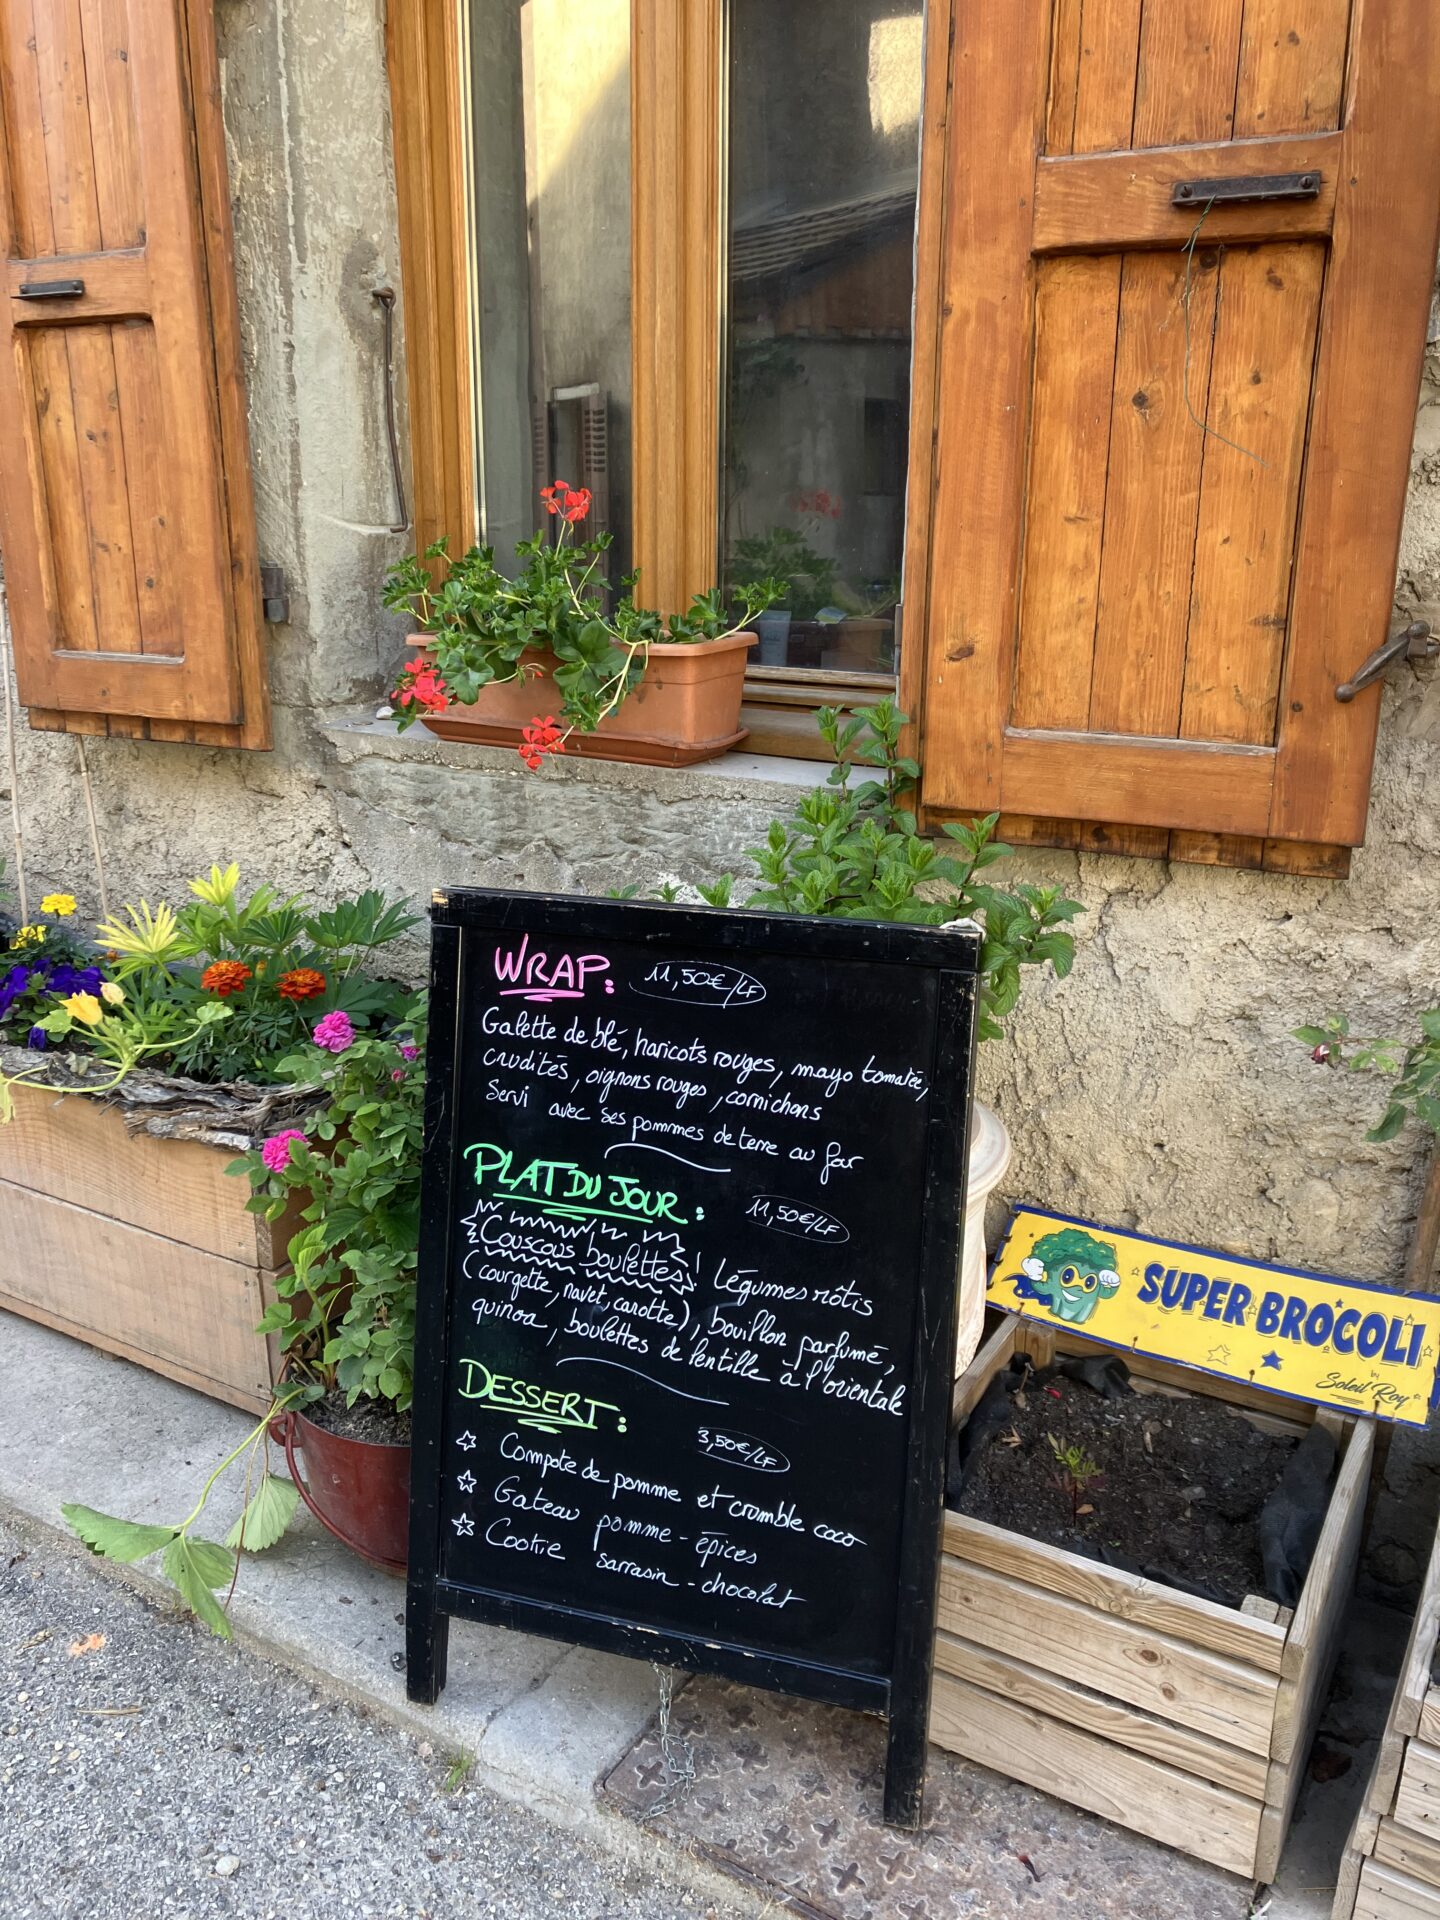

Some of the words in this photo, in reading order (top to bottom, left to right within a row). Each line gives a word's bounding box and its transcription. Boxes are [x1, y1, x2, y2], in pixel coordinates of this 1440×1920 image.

[495, 933, 616, 993] WRAP:
[482, 1006, 557, 1040] Galette
[563, 1016, 588, 1045] de
[591, 1017, 630, 1060] blé,
[634, 1028, 708, 1064] haricots
[713, 1054, 784, 1090] rouges,
[790, 1064, 853, 1098] mayo
[585, 1067, 651, 1104] oignons
[725, 1092, 823, 1121] cornichons
[463, 1143, 579, 1196] PLAT
[563, 1170, 602, 1200] DU
[548, 1102, 591, 1121] avec
[600, 1107, 627, 1126] ses
[631, 1115, 705, 1142] pommes
[713, 1123, 736, 1147] de
[738, 1126, 779, 1156] terre
[789, 1147, 816, 1162] au
[820, 1141, 865, 1186] four
[480, 1214, 576, 1259] Couscous
[707, 1305, 788, 1347] bouillon
[811, 1279, 873, 1317] rôtis
[1136, 1262, 1253, 1328] SUPER
[1255, 1290, 1427, 1369] BROCOLI
[563, 1307, 649, 1354] boulettes
[661, 1336, 683, 1361] de
[688, 1338, 771, 1382] lentille
[1315, 1371, 1374, 1394] Soleil
[1370, 1382, 1411, 1411] Roy
[1370, 1369, 1380, 1381] by
[494, 1475, 580, 1521] Gateau
[593, 1514, 672, 1552] pomme
[500, 1432, 577, 1479] Compote
[581, 1458, 610, 1484] de
[612, 1472, 682, 1500] pomme
[697, 1484, 735, 1509] et
[813, 1523, 868, 1547] coco
[701, 1572, 807, 1609] chocolat
